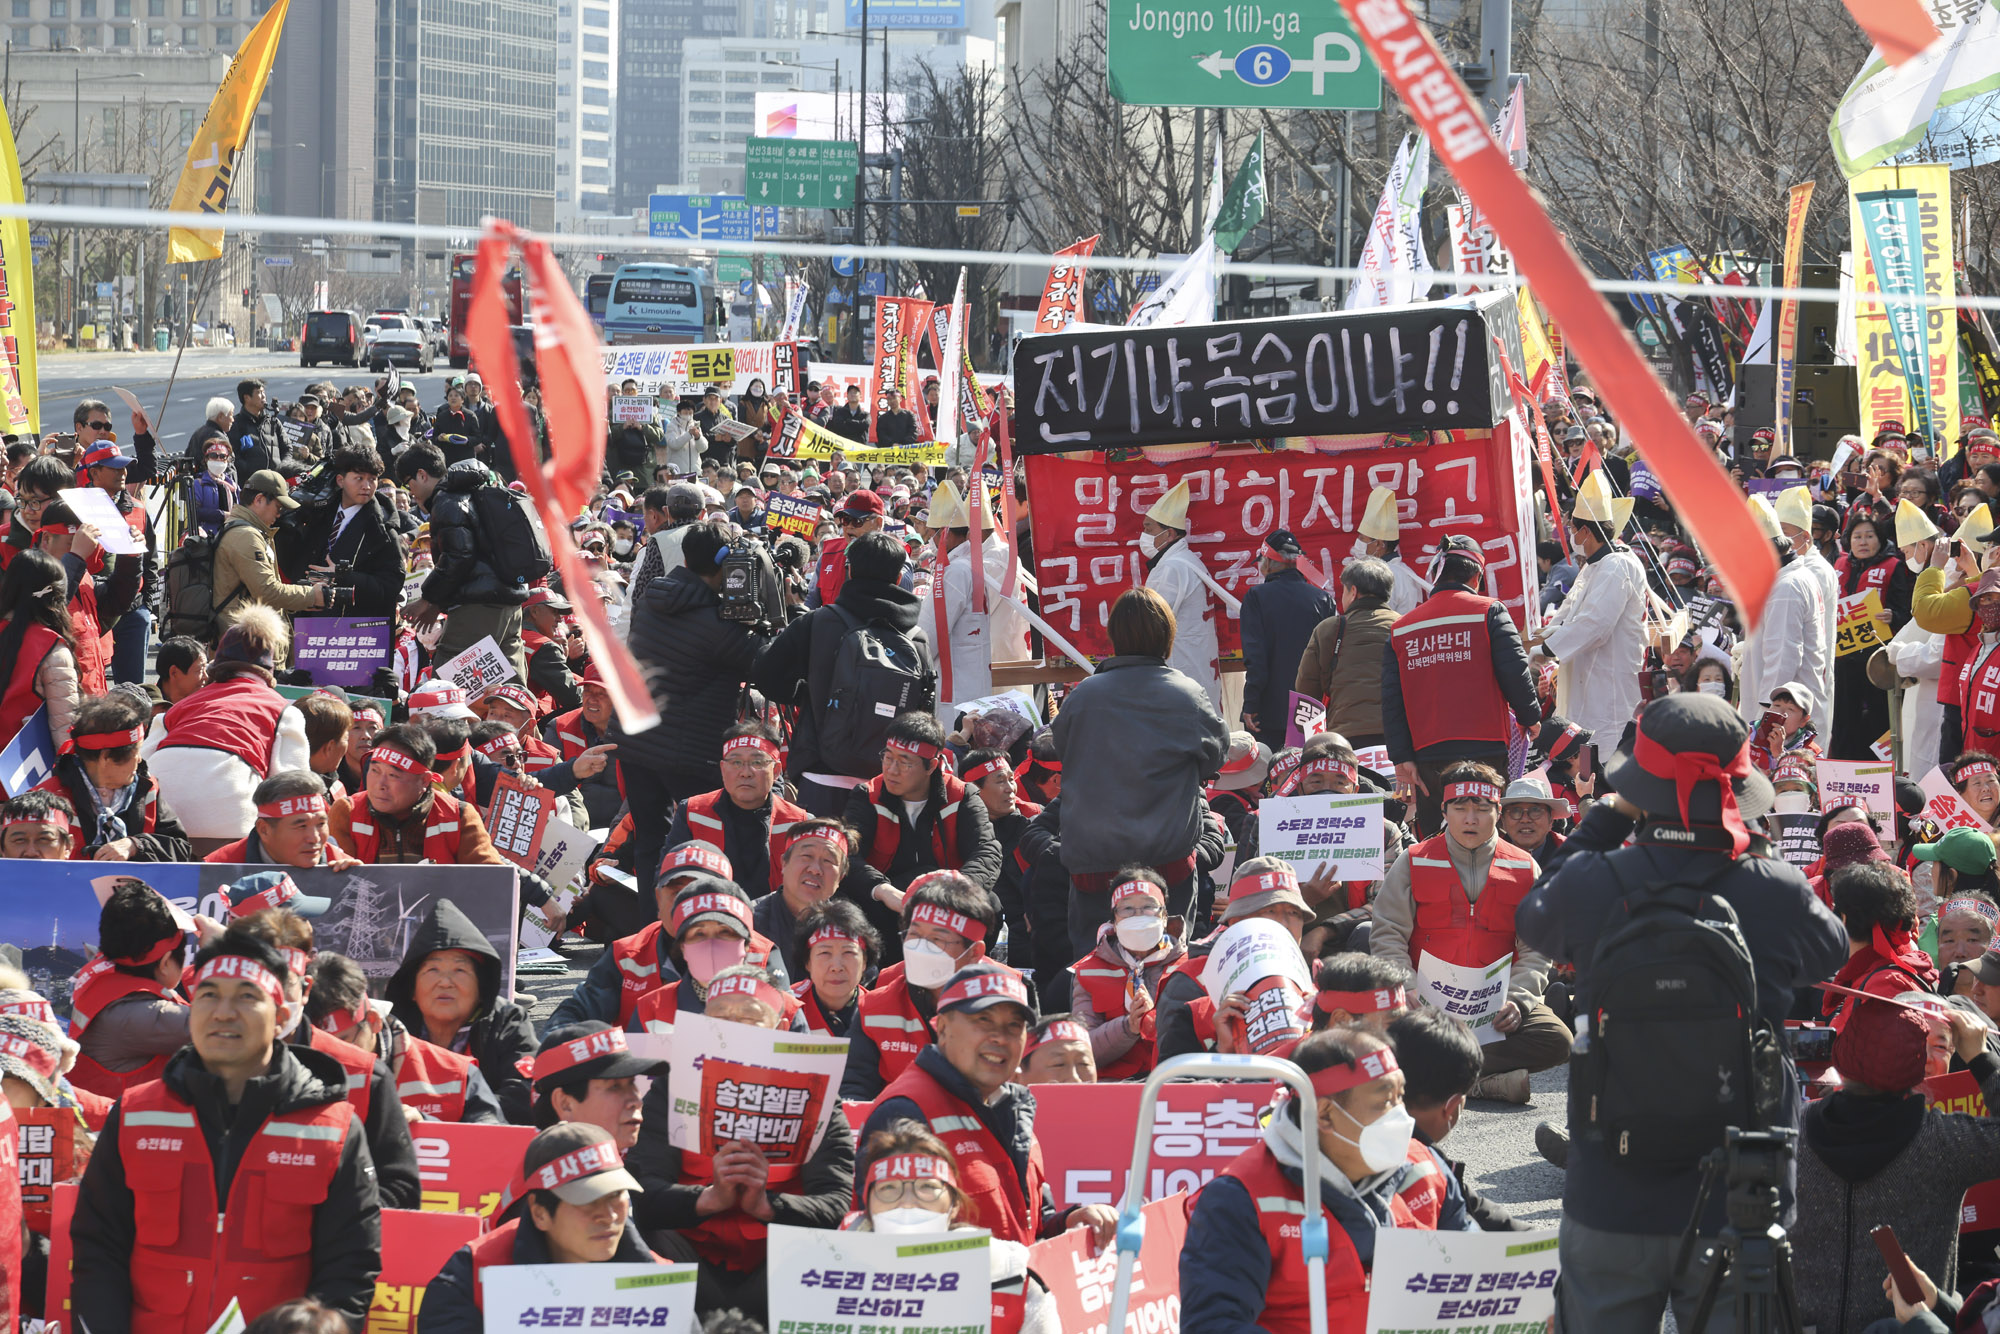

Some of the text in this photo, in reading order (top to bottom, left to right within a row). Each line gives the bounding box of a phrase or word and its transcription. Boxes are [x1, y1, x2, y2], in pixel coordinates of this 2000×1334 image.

[1129, 3, 1300, 41] Jongno 1(il)-ga
[1252, 52, 1273, 80] 6
[822, 148, 857, 159] 신촌로터리
[641, 307, 682, 315] Limousine
[691, 353, 732, 378] 금산
[772, 413, 804, 458] 결사
[883, 451, 920, 463] 금산군
[769, 496, 819, 522] 송전선로
[765, 511, 815, 537] 결사반대
[307, 636, 377, 646] 주민 수용성 없는
[1405, 630, 1472, 657] 결사반대
[298, 647, 318, 659] 용인
[349, 647, 385, 659] 송전선로
[1407, 650, 1472, 671] 신북면대책위원회
[326, 660, 358, 672] 무효다!
[899, 681, 910, 708] THULE
[1305, 759, 1351, 775] 결사반대
[1846, 782, 1880, 795] 전력수요
[494, 789, 523, 851] 건설반대
[511, 794, 542, 857] 송전철탑
[1277, 816, 1366, 832] 수도권 전력수요
[1296, 832, 1346, 846] 분산하고
[1653, 828, 1696, 843] Canon
[1332, 846, 1380, 861] 마련하라!
[681, 892, 745, 918] 결사반대
[1430, 979, 1469, 1002] 수도권
[1444, 1000, 1490, 1016] 분산하고
[715, 1079, 811, 1116] 송전철탑
[712, 1108, 803, 1146] 건설반대
[136, 1137, 184, 1152] 송전철탑
[266, 1151, 316, 1167] 송전선로
[539, 1142, 617, 1189] 결사반대
[874, 1156, 949, 1180] 결사반대
[801, 1268, 960, 1293] 수도권 전력수요
[1405, 1269, 1558, 1294] 수도권 전력수요
[519, 1305, 669, 1328] 수도권 전력수요
[836, 1297, 924, 1319] 분산하고
[1436, 1296, 1522, 1321] 분산하고
